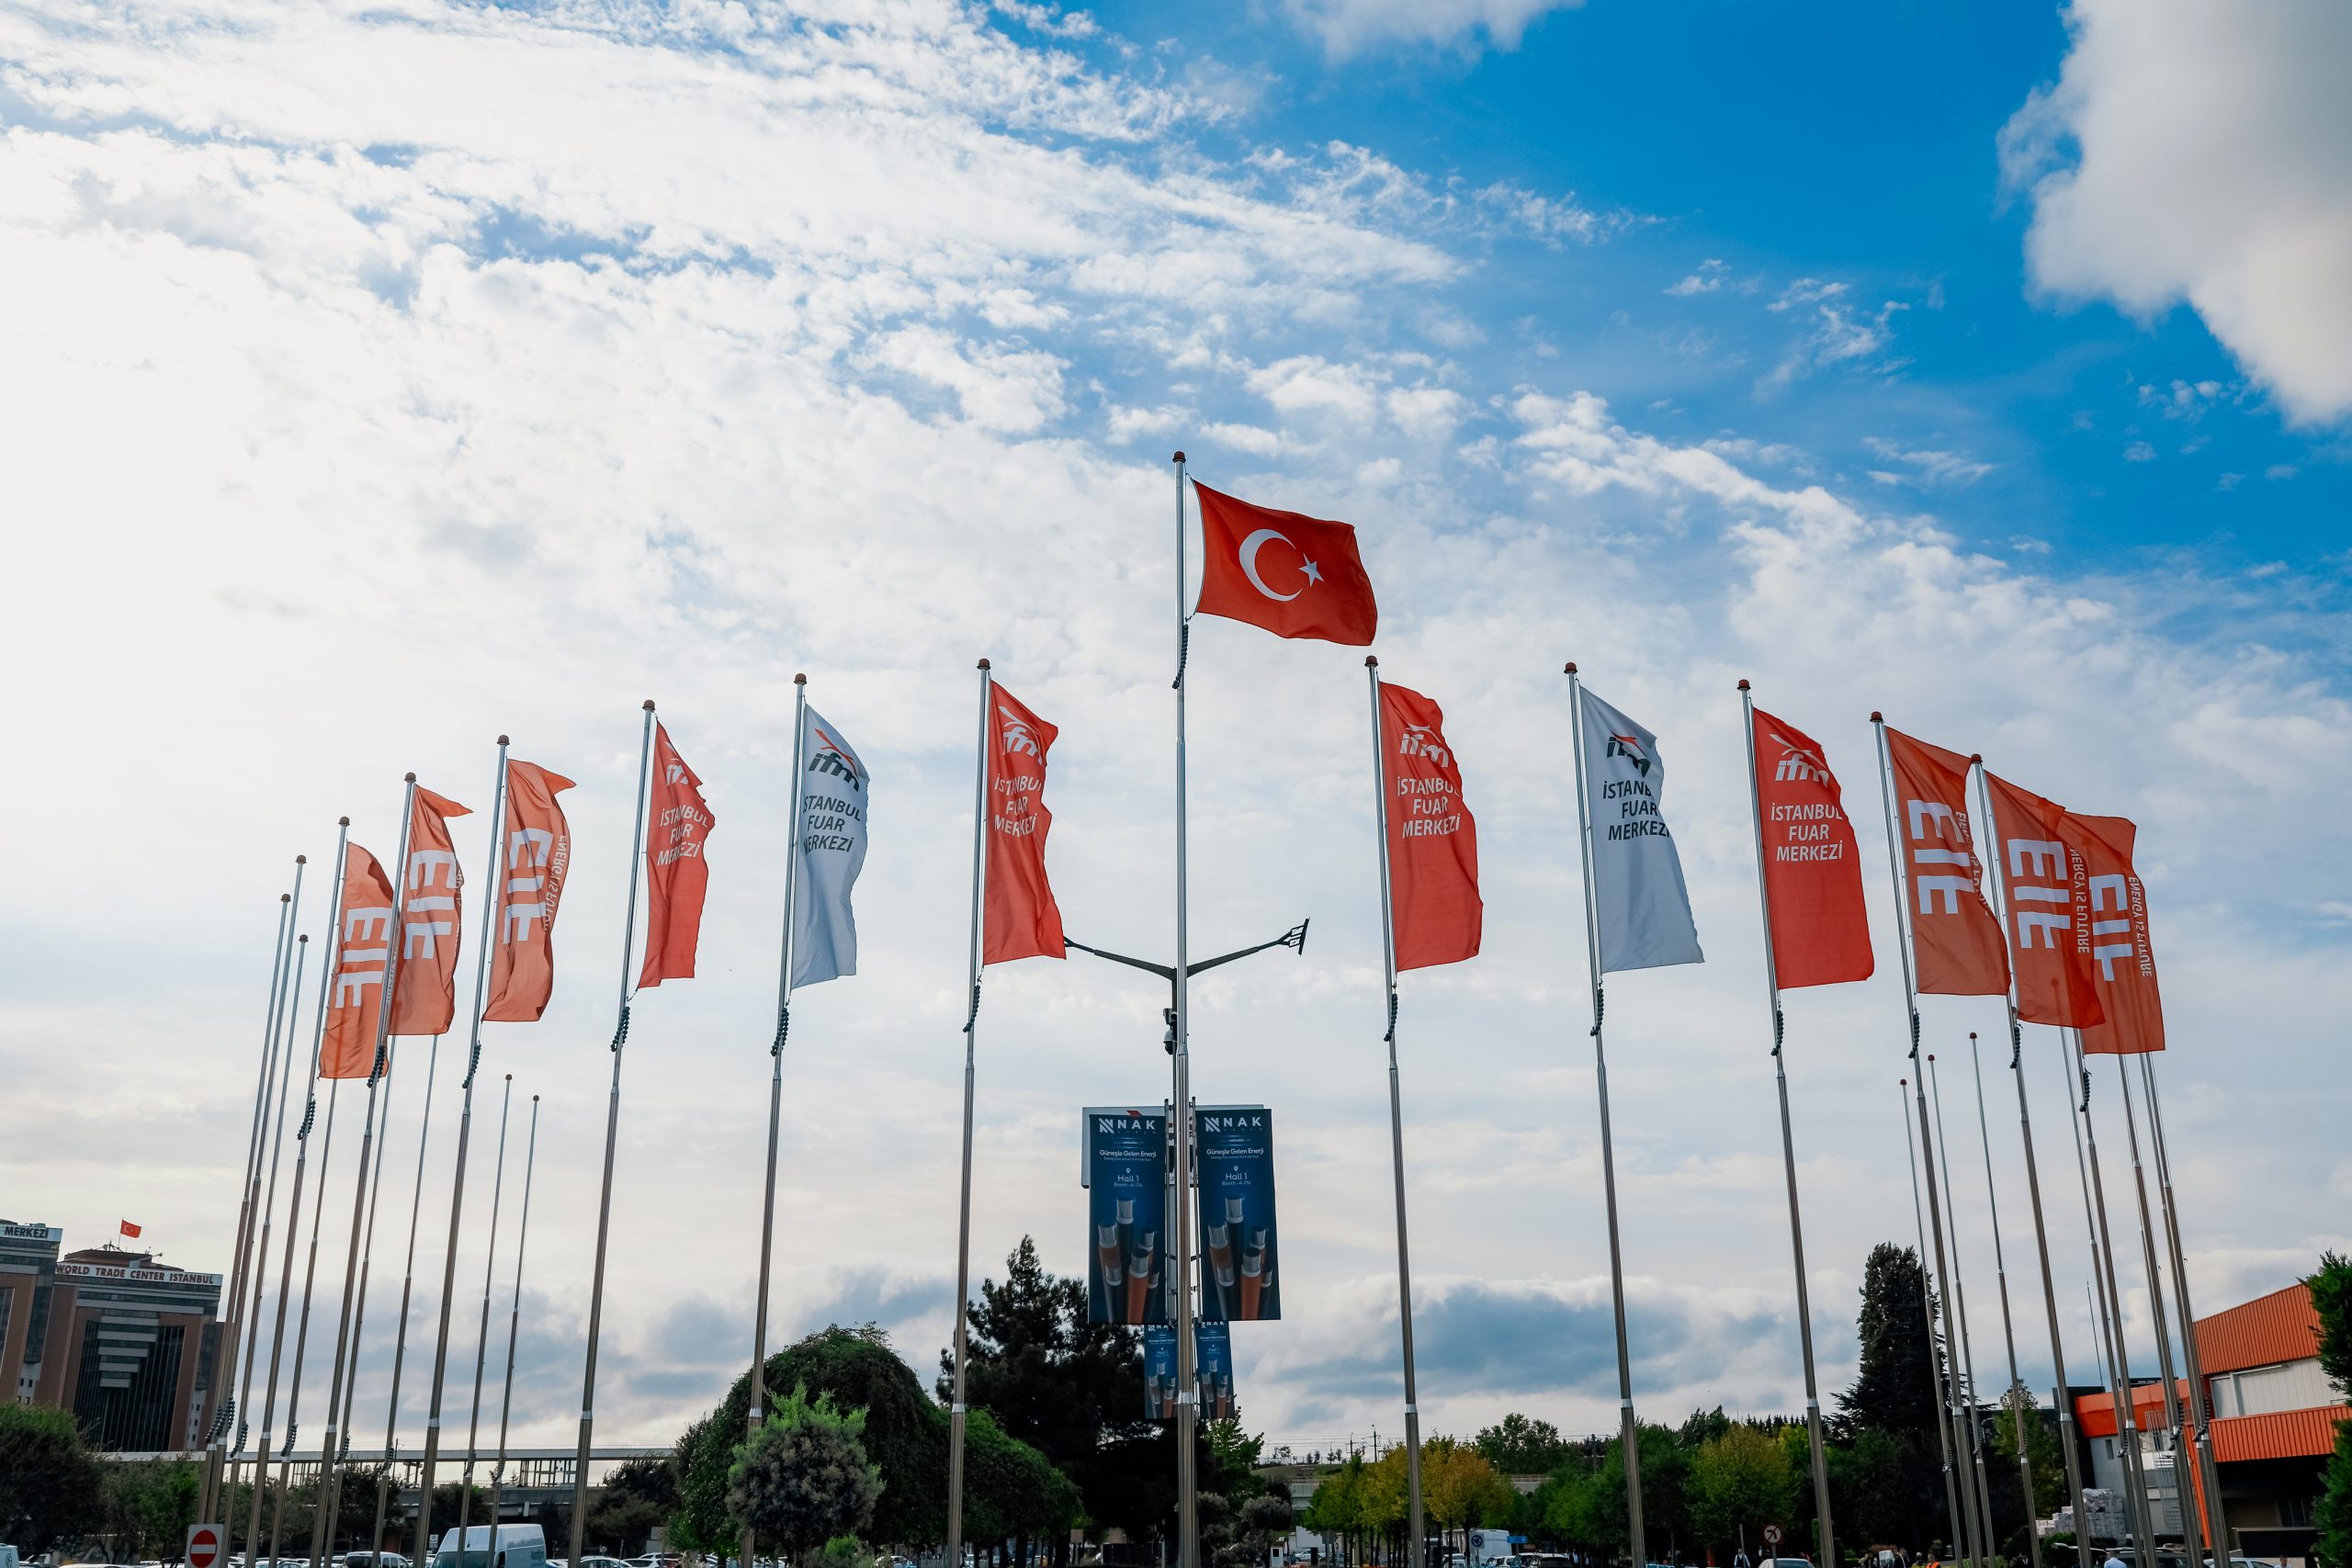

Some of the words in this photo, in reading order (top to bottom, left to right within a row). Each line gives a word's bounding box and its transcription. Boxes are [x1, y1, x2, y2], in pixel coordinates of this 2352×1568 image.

[808, 752, 860, 793] ifm
[1774, 752, 1830, 788] ifm
[802, 795, 861, 822] STANBUL
[1412, 795, 1449, 816] FUAR
[1622, 799, 1658, 819] FUAR
[1770, 802, 1844, 821] İSTANBUL
[808, 815, 846, 832] FUAR
[1402, 813, 1461, 840] MERKEZİ
[1788, 823, 1830, 841] FUAR
[1776, 840, 1844, 862] MERKEZİ
[1117, 1120, 1155, 1130] NAK
[1223, 1117, 1261, 1127] NAK
[1140, 1150, 1157, 1158] Enerji
[1248, 1147, 1264, 1156] Enerji
[1117, 1174, 1135, 1182] Hall
[56, 1264, 90, 1275] WORLD
[96, 1267, 126, 1278] TRADE
[130, 1269, 165, 1281] CENTER
[169, 1272, 214, 1284] ISTANBUL
